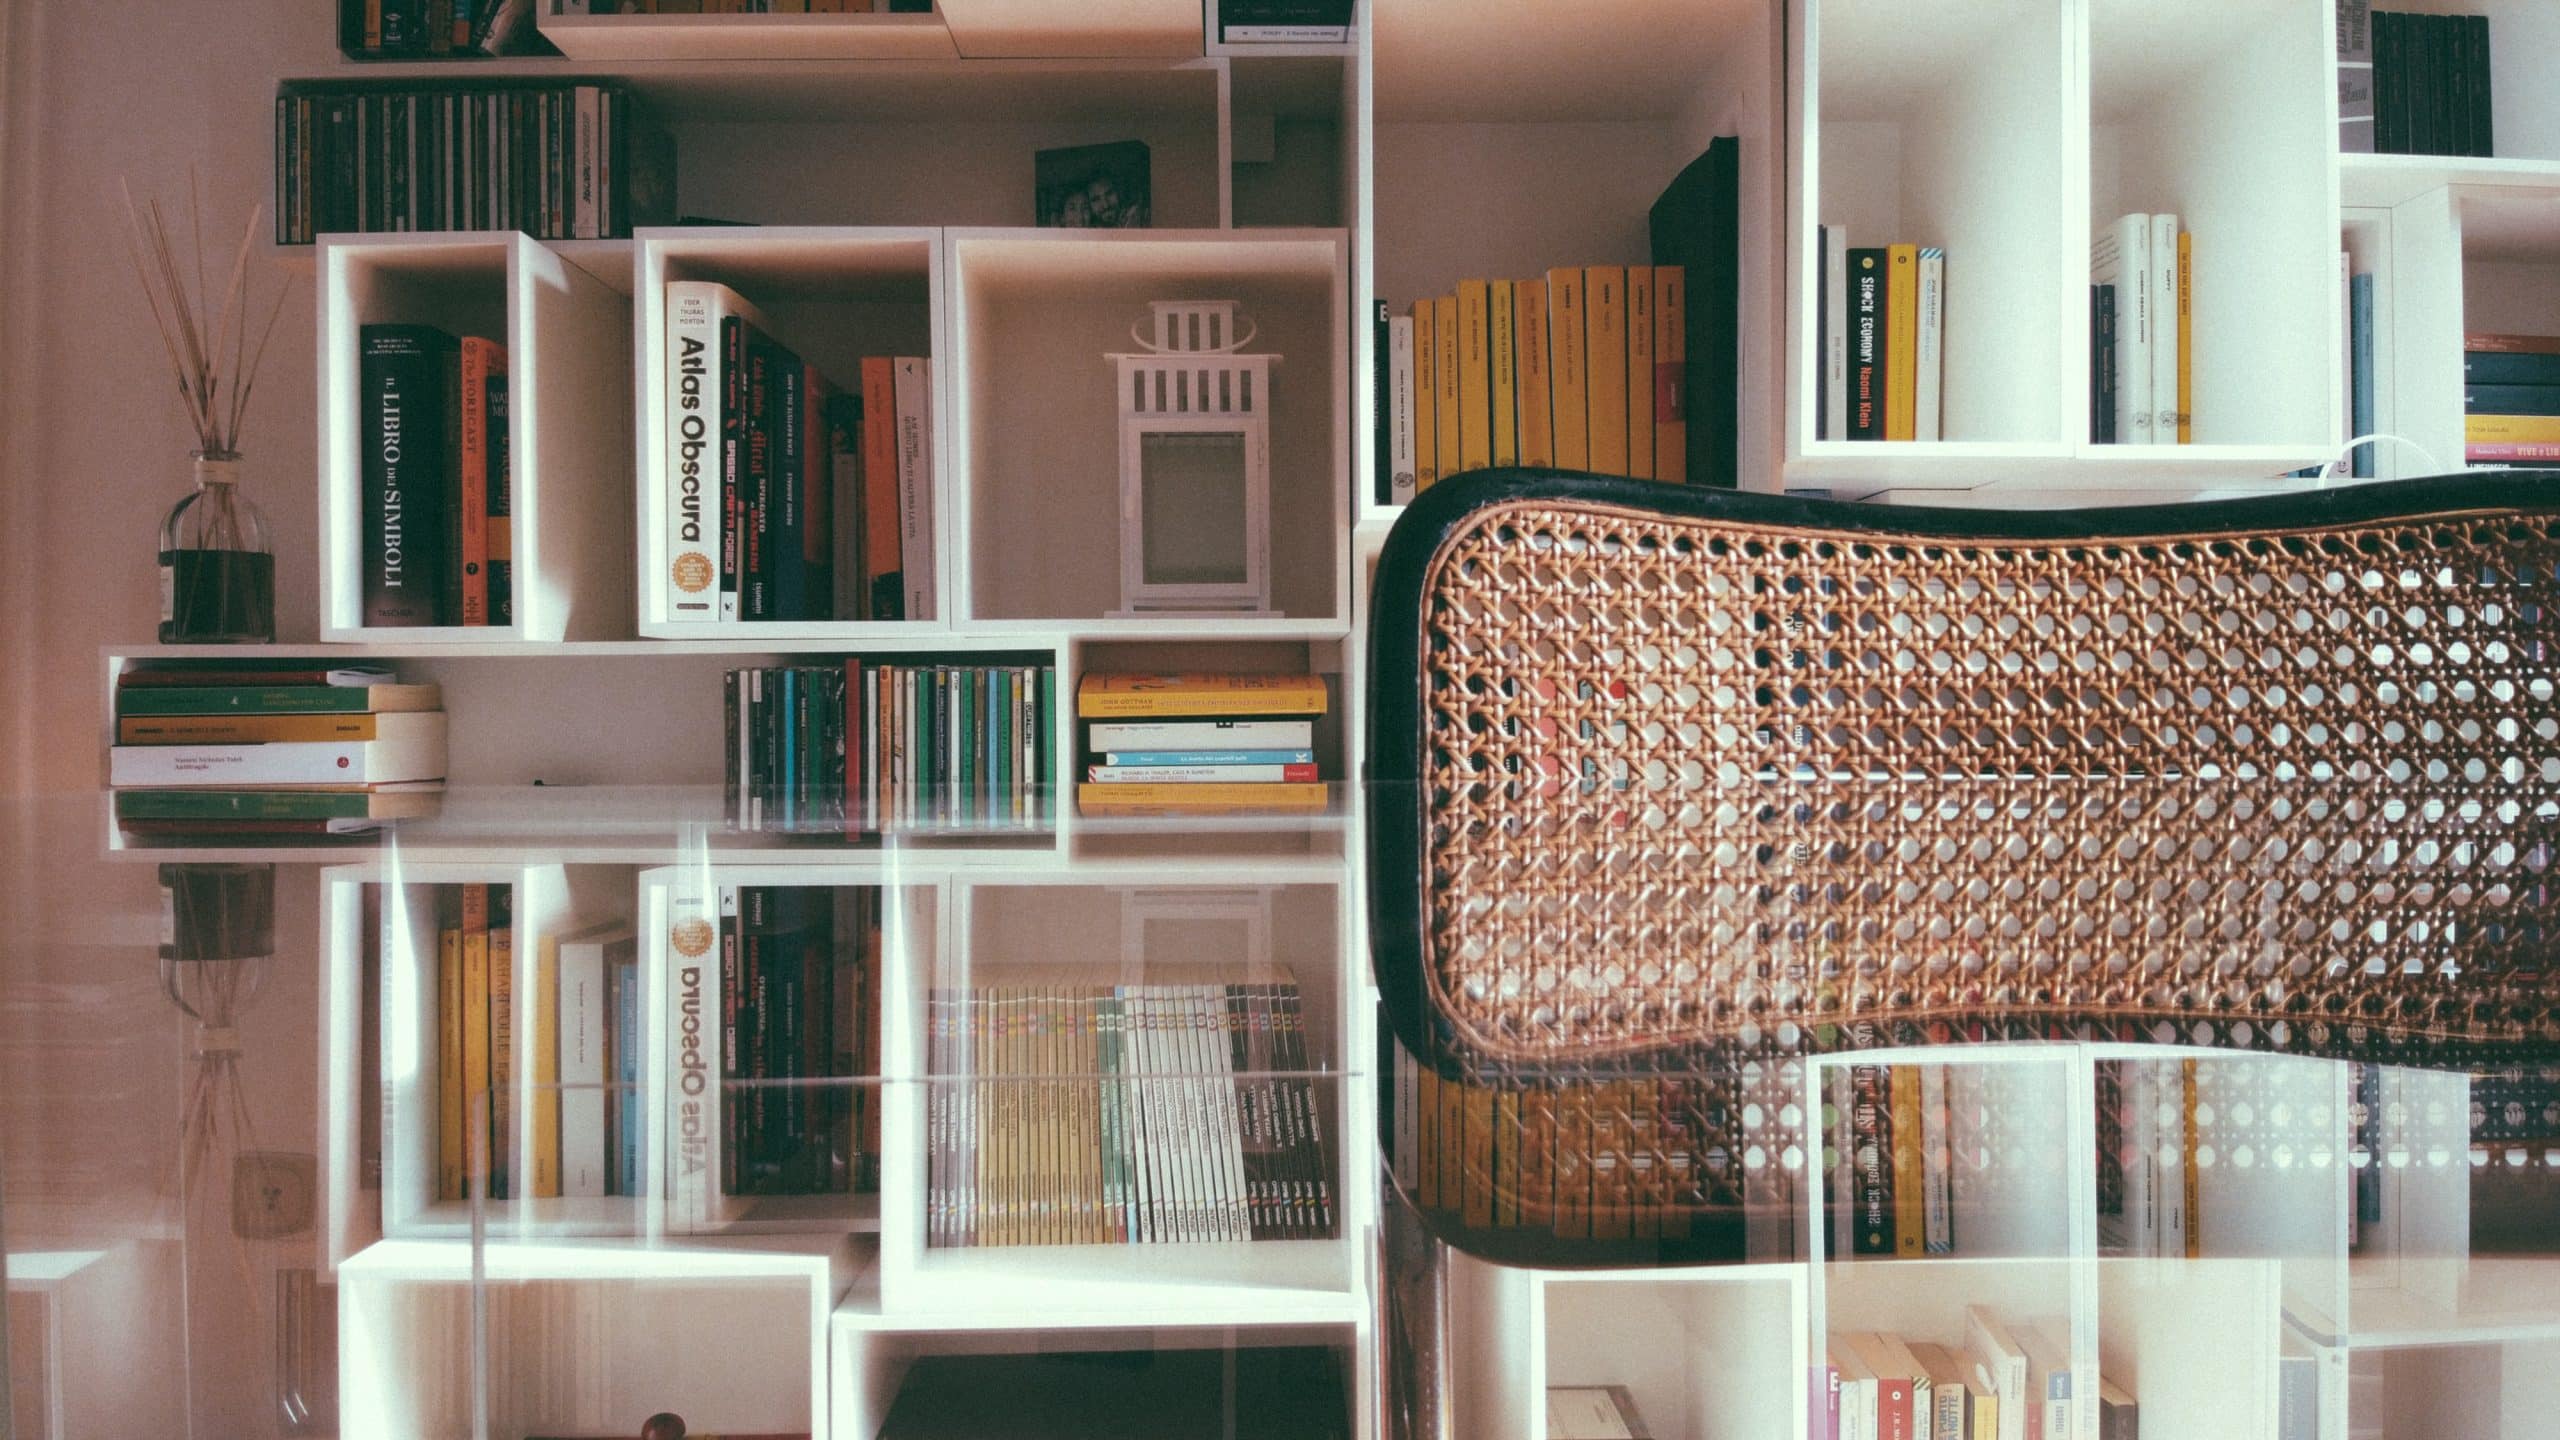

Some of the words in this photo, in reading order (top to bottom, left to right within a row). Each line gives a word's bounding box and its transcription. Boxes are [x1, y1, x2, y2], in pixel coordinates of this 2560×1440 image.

[1861, 318, 1873, 364] ECONOMY
[681, 336, 706, 410] Atlas
[1860, 367, 1872, 398] Naomi
[383, 393, 400, 464] LIBRO
[466, 381, 477, 454] FORECAST
[1858, 402, 1870, 428] Klein
[726, 440, 736, 482] SASSO
[2517, 448, 2536, 456] VIVE
[386, 468, 396, 486] DEI
[681, 415, 706, 542] Obscura
[384, 490, 402, 588] SIMBOLI
[756, 582, 764, 614] tsunami
[497, 940, 510, 1004] EKHART
[1261, 1089, 1269, 1116] APERTA
[1269, 1080, 1278, 1111] QUATTRO
[1264, 1118, 1272, 1136] CITTÀ
[1272, 1112, 1281, 1140] NUMERO
[1297, 1119, 1305, 1138] COME
[1949, 1395, 1958, 1430] NOTTE
